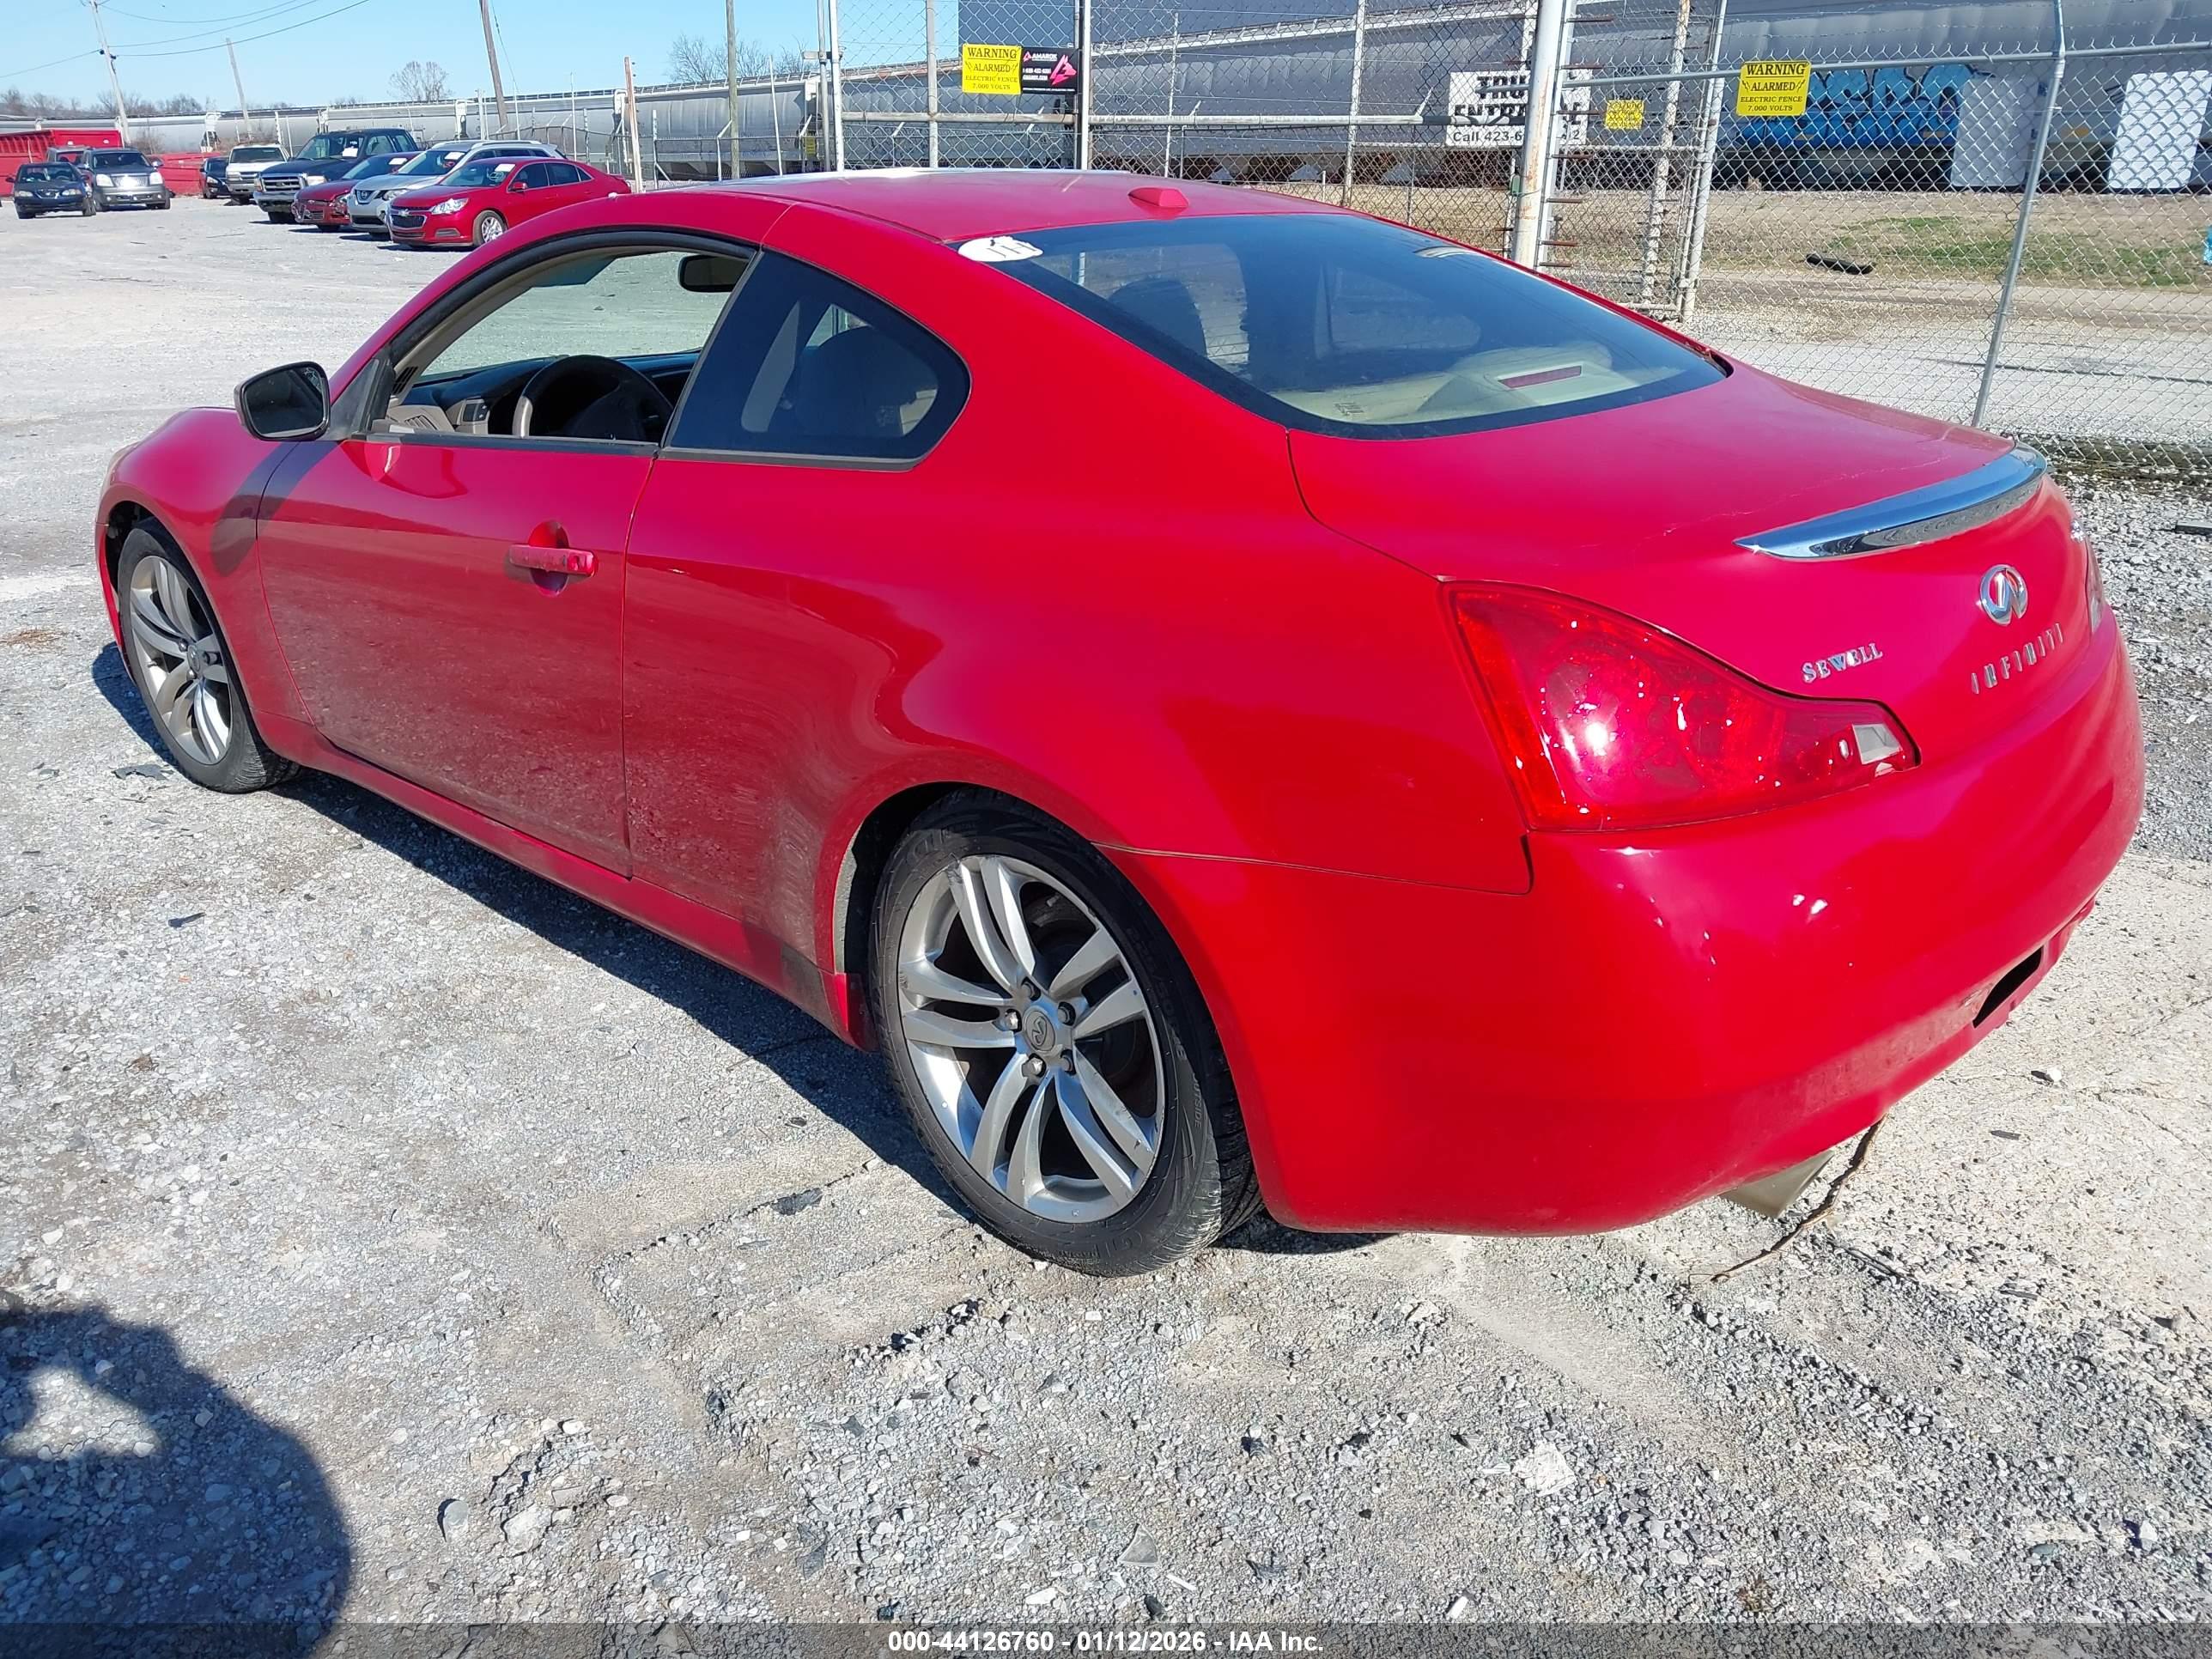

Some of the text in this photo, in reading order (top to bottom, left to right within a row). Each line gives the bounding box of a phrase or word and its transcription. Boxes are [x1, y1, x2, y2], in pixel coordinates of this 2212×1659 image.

[967, 47, 1018, 59] WARNING
[973, 63, 1011, 72] ALARMED
[1747, 64, 1805, 75] WARNING
[1750, 82, 1796, 92] ALARMED
[1453, 131, 1480, 142] Call
[1802, 642, 1884, 684] SEWELL
[1970, 622, 2064, 695] INFINITI
